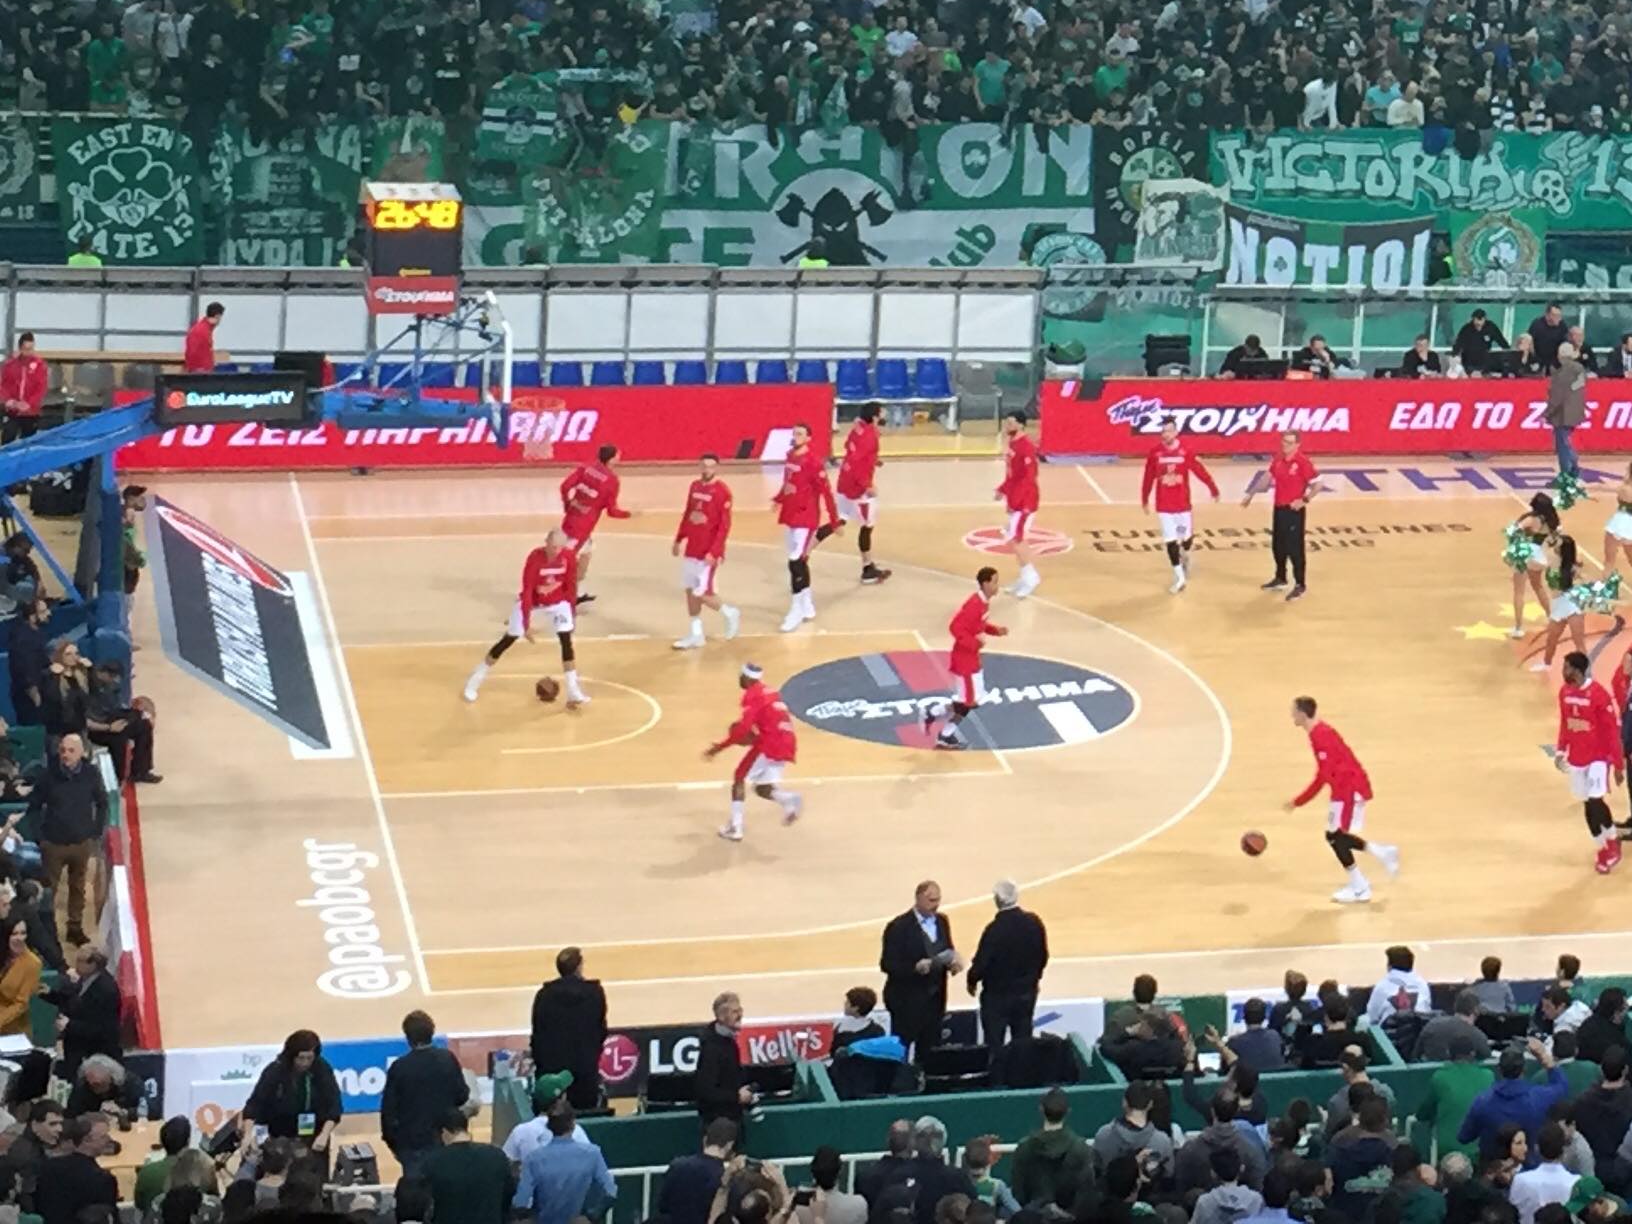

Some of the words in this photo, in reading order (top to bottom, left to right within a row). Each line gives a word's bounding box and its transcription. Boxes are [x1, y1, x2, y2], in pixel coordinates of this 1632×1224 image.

[67, 123, 132, 165] EAST
[1217, 137, 1508, 200] VICTORIA
[1389, 402, 1461, 429] ΕΔΩ
[650, 1036, 701, 1075] LG
